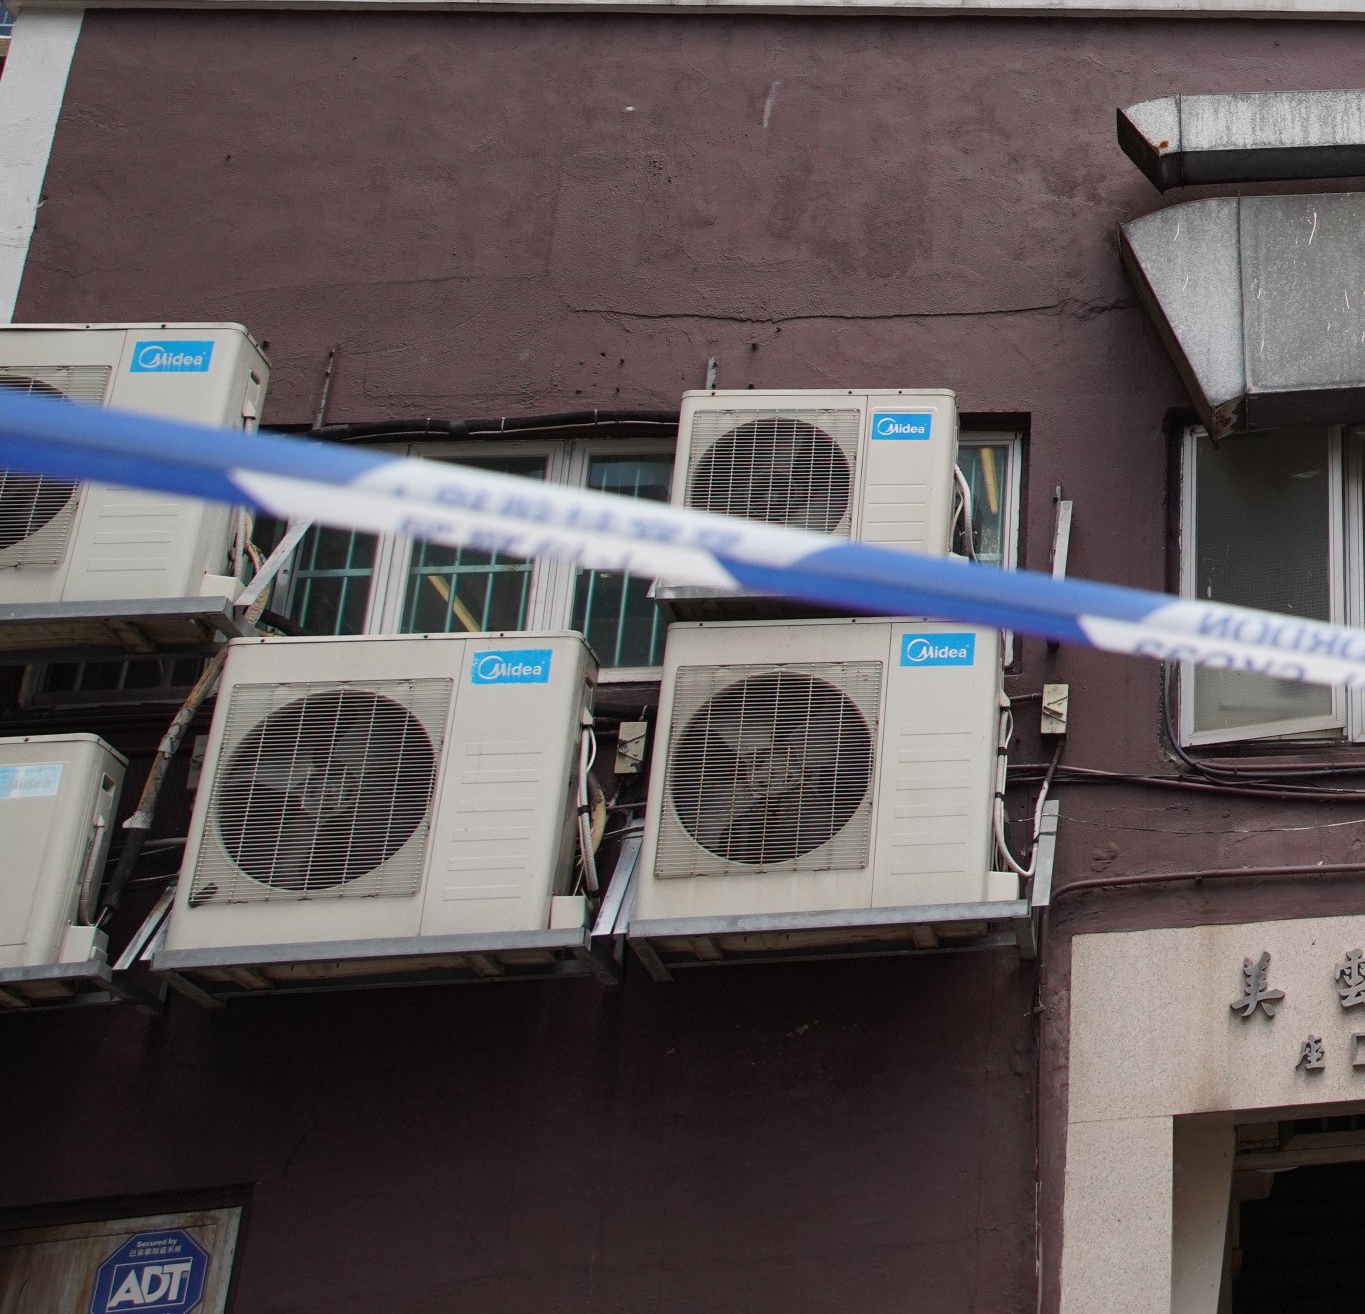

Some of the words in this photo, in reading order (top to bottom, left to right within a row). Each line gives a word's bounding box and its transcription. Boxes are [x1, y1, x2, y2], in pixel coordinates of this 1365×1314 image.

[142, 349, 204, 367] Midea
[882, 420, 925, 434] Midea
[912, 643, 967, 659] Midea
[483, 659, 542, 677] Midea
[136, 1238, 167, 1248] Secured
[168, 1238, 178, 1247] by
[107, 1262, 191, 1307] ADT
